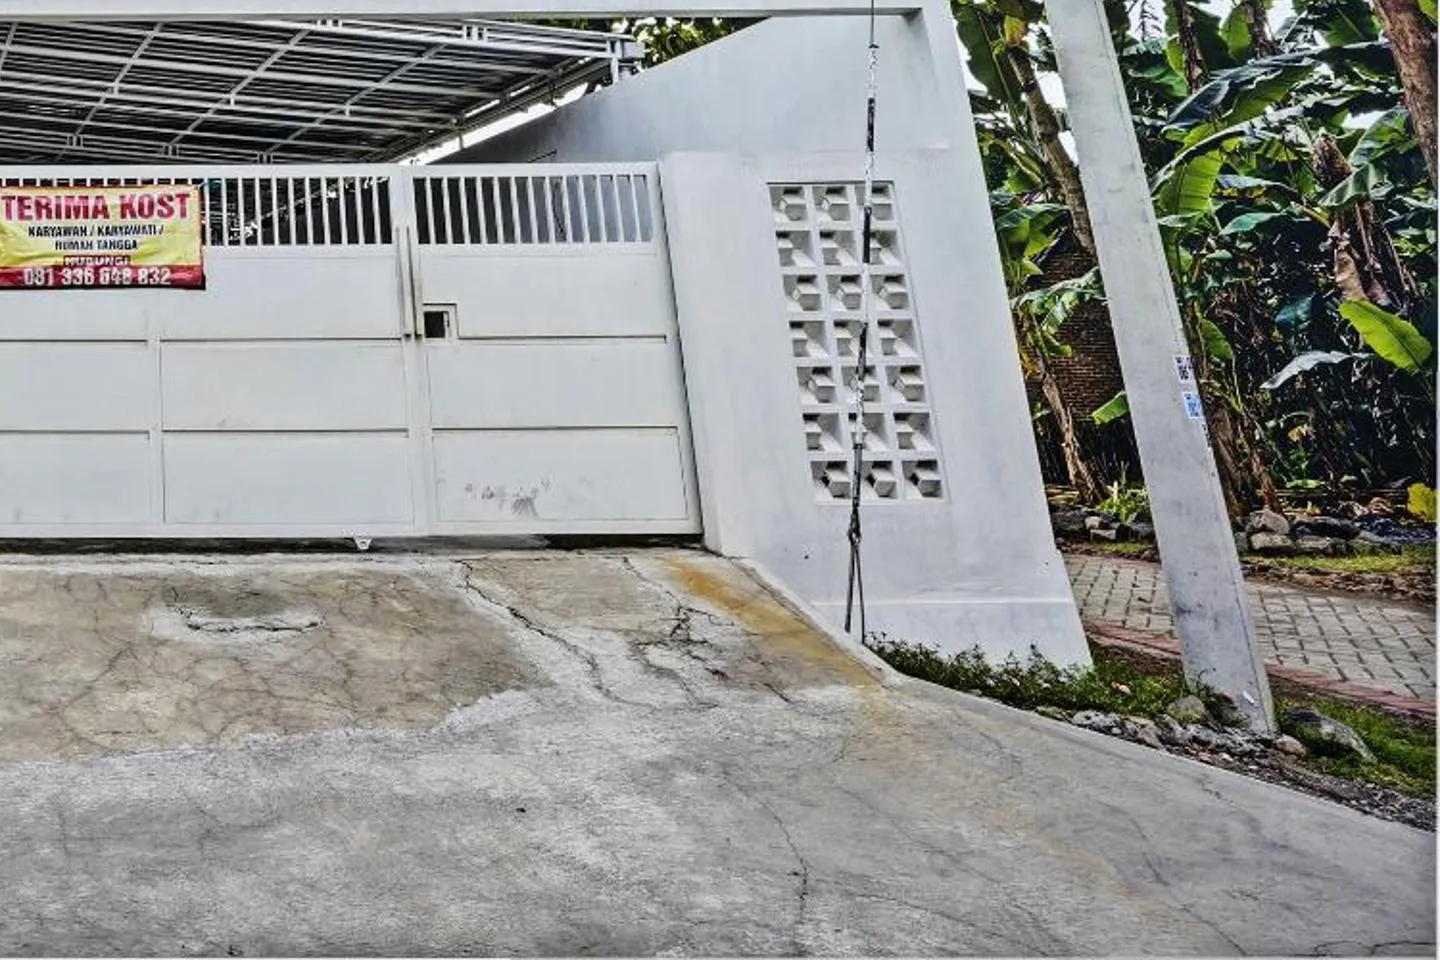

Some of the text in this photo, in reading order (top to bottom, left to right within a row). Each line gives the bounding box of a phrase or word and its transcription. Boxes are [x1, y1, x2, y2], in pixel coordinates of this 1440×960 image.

[1, 192, 191, 221] TERIMA KOST
[96, 239, 137, 251] TANGGA
[23, 268, 54, 286] 081
[137, 266, 172, 286] 832
